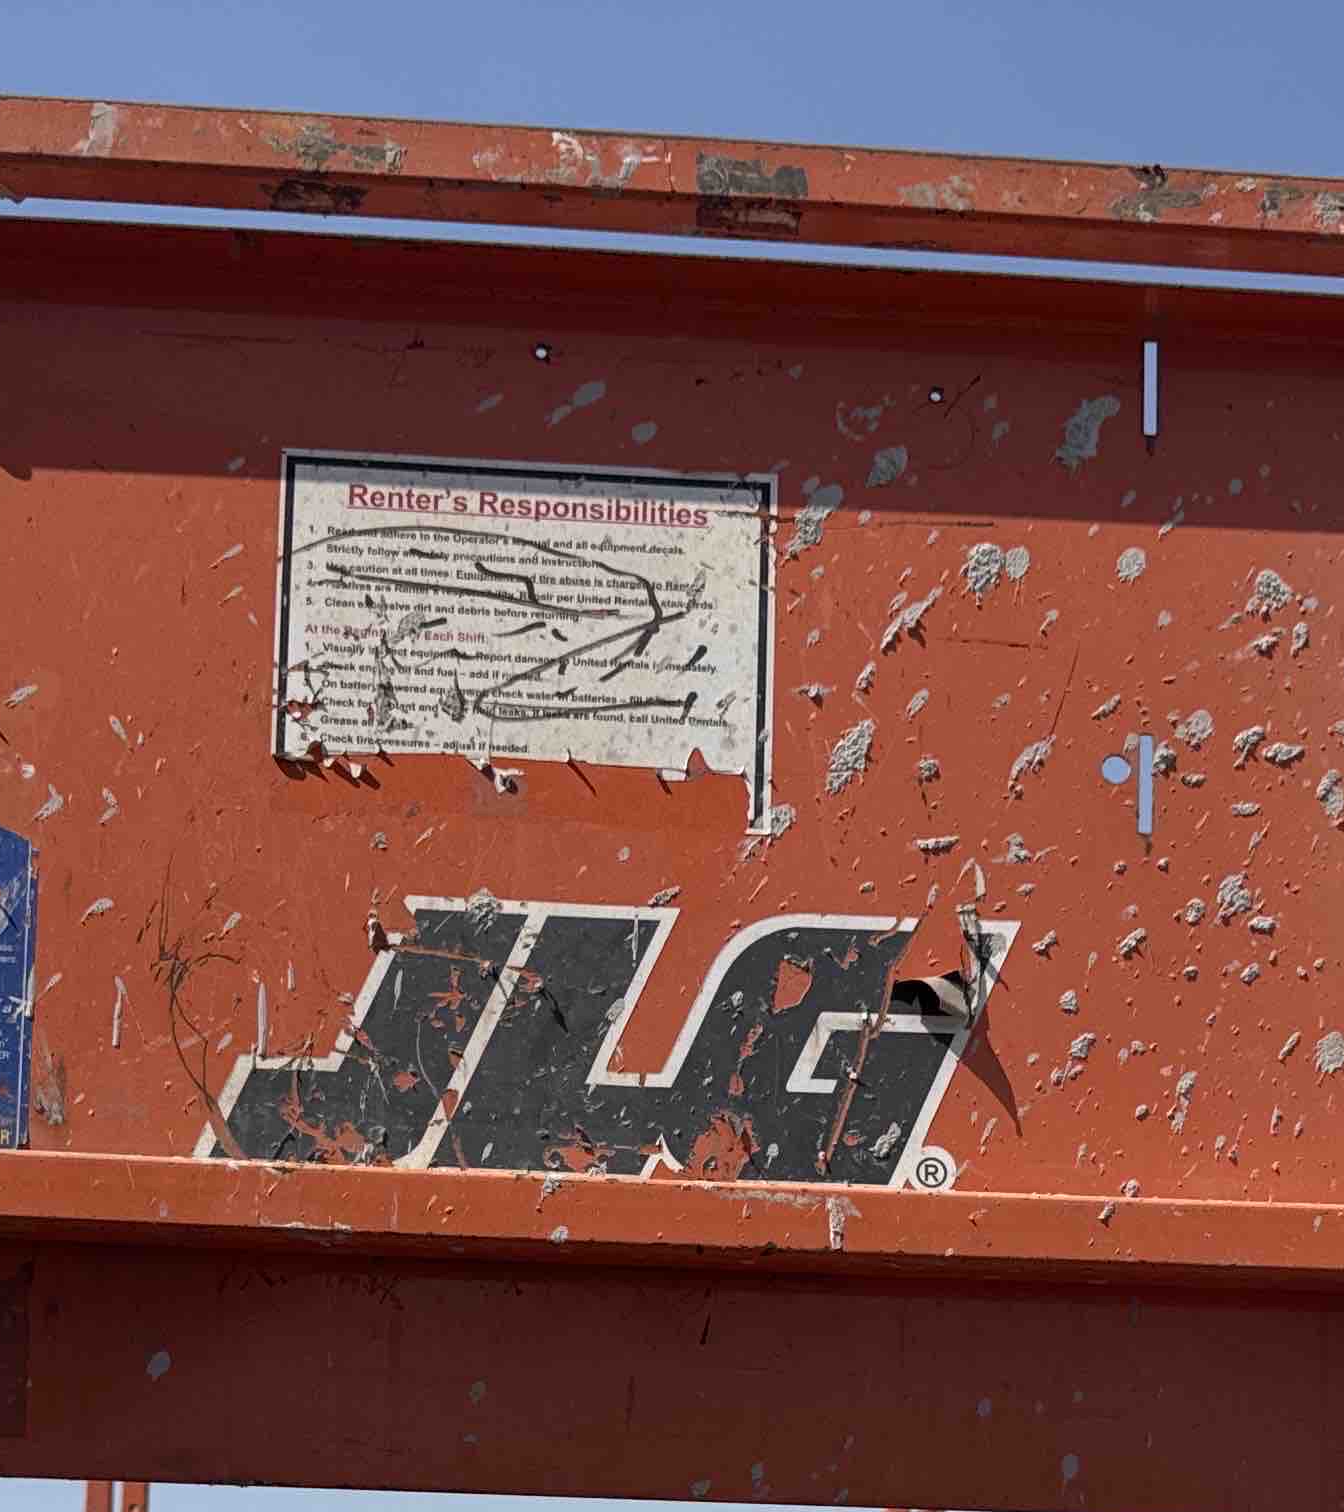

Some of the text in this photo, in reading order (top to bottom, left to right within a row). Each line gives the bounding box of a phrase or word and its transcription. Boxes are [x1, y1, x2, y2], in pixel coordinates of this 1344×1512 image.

[348, 483, 709, 525] Renter's Responsibilities
[434, 533, 449, 542] the
[453, 534, 508, 544] Operator's
[553, 540, 572, 549] and
[576, 540, 588, 549] all
[327, 543, 364, 556] Strictly
[368, 546, 400, 557] follow
[453, 551, 516, 563] precautions
[518, 556, 538, 564] and
[350, 564, 389, 574] caution
[392, 566, 402, 575] at
[404, 567, 417, 576] all
[560, 576, 591, 586] abuse
[594, 578, 603, 587] is
[324, 598, 355, 609] Clean
[435, 604, 454, 614] and
[458, 606, 491, 615] debris
[494, 606, 527, 618] before
[556, 594, 574, 604] per
[577, 594, 611, 605] United
[305, 624, 318, 633] At
[322, 625, 340, 634] the
[425, 630, 454, 641] Each
[322, 641, 365, 656] Visually
[572, 656, 607, 668] United
[414, 668, 434, 676] and
[469, 669, 489, 679] add
[321, 680, 337, 688] On
[571, 692, 617, 704] batteries
[320, 716, 358, 725] Grease
[418, 703, 438, 713] and
[651, 714, 685, 725] United
[320, 733, 353, 744] Check
[443, 741, 475, 753] adjust
[191, 894, 1022, 1188] JLG
